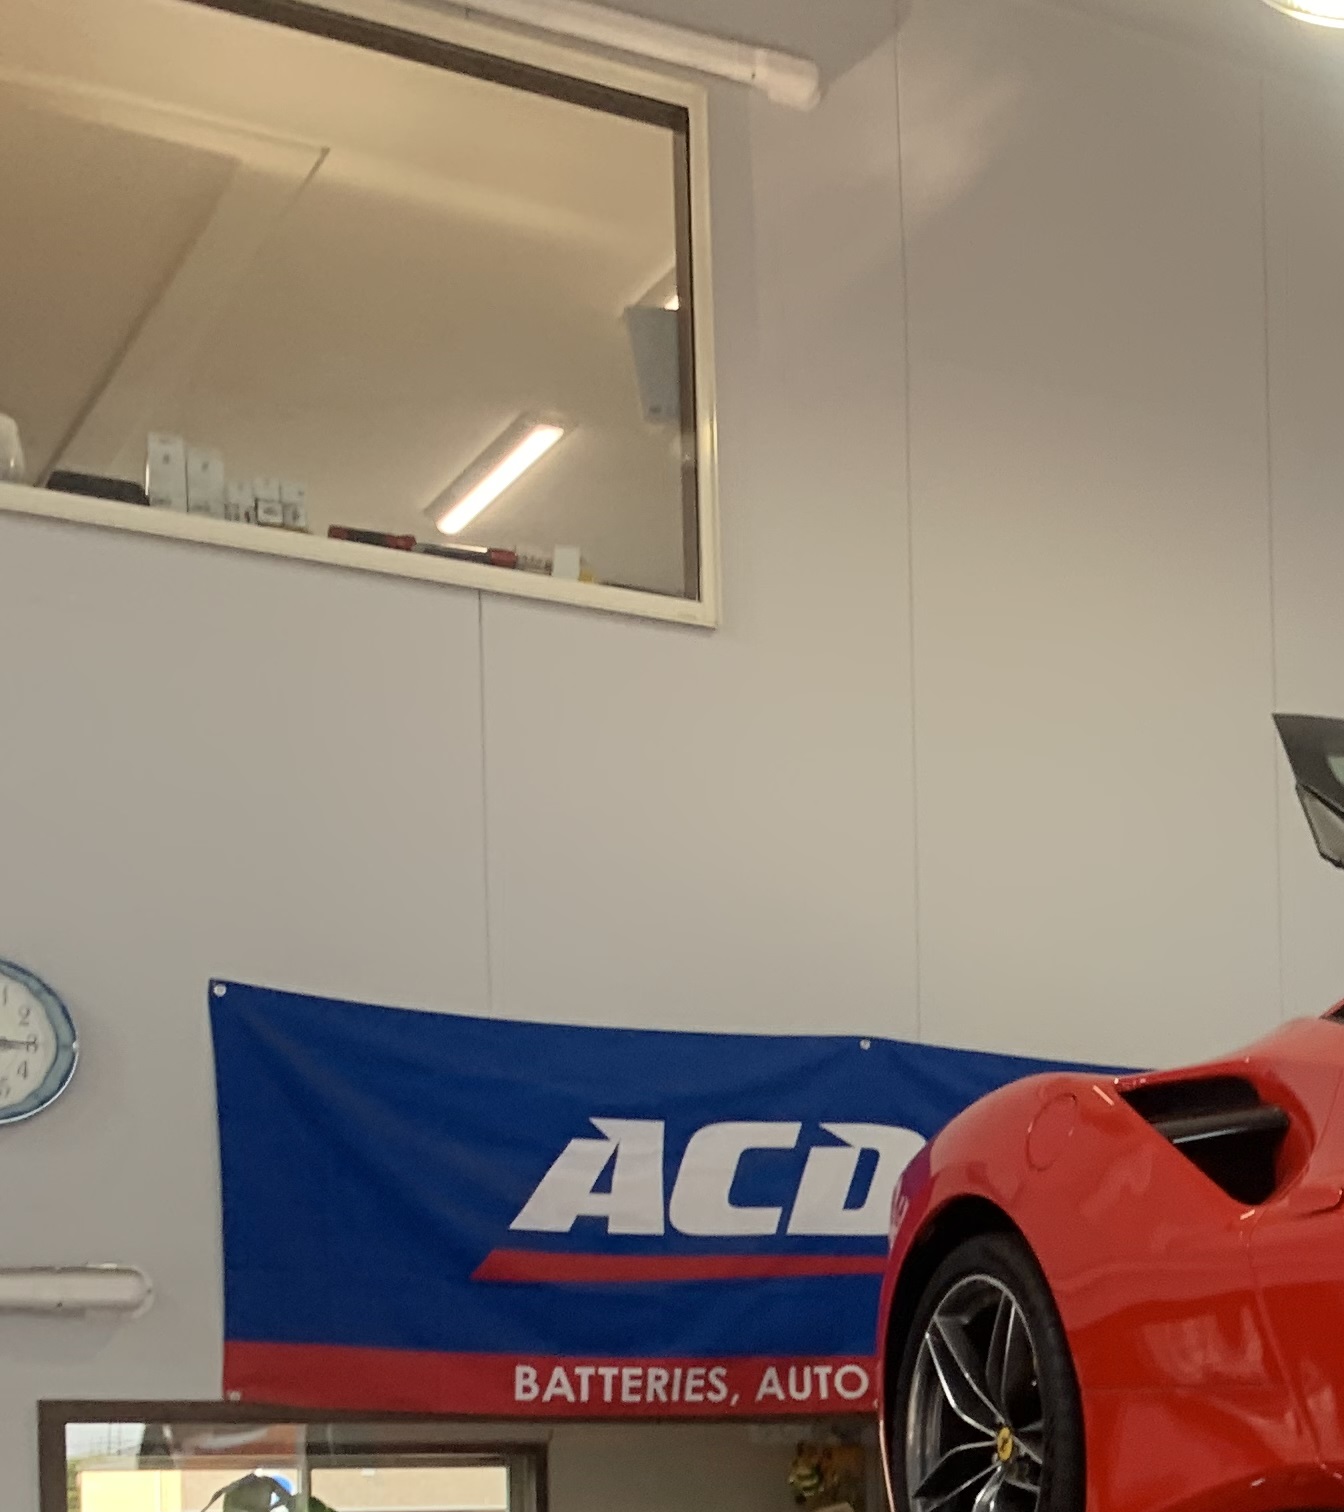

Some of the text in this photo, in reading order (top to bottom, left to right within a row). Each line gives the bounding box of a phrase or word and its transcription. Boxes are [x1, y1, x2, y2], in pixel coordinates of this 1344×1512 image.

[19, 1006, 31, 1027] 2
[17, 1060, 29, 1081] 4
[513, 1363, 870, 1406] BATTERIES, AUTO
